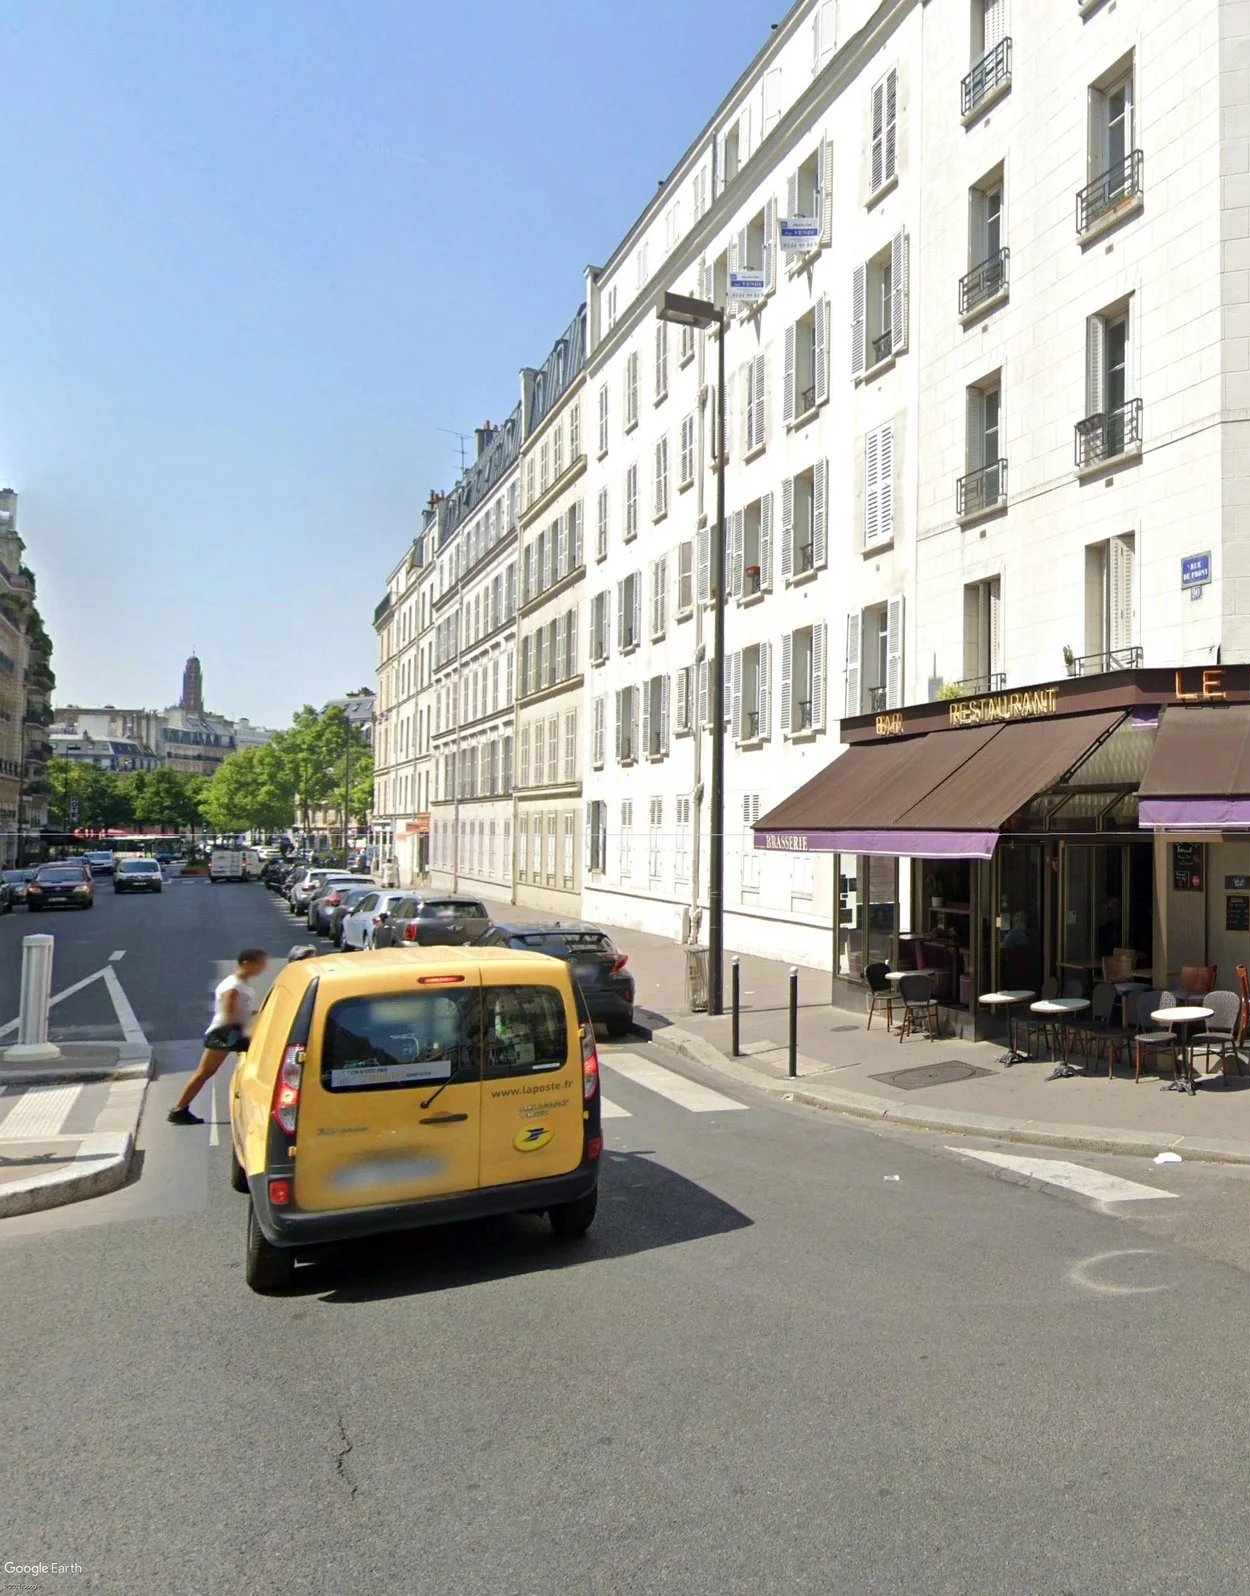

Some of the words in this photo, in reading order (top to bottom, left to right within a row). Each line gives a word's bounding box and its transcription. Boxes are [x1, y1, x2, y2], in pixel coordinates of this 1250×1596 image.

[1175, 668, 1227, 699] LE
[949, 686, 1060, 726] RESTAURANT
[875, 712, 904, 736] BAR
[765, 835, 808, 851] BRASSERIE
[491, 1080, 574, 1099] www.laposte.fr
